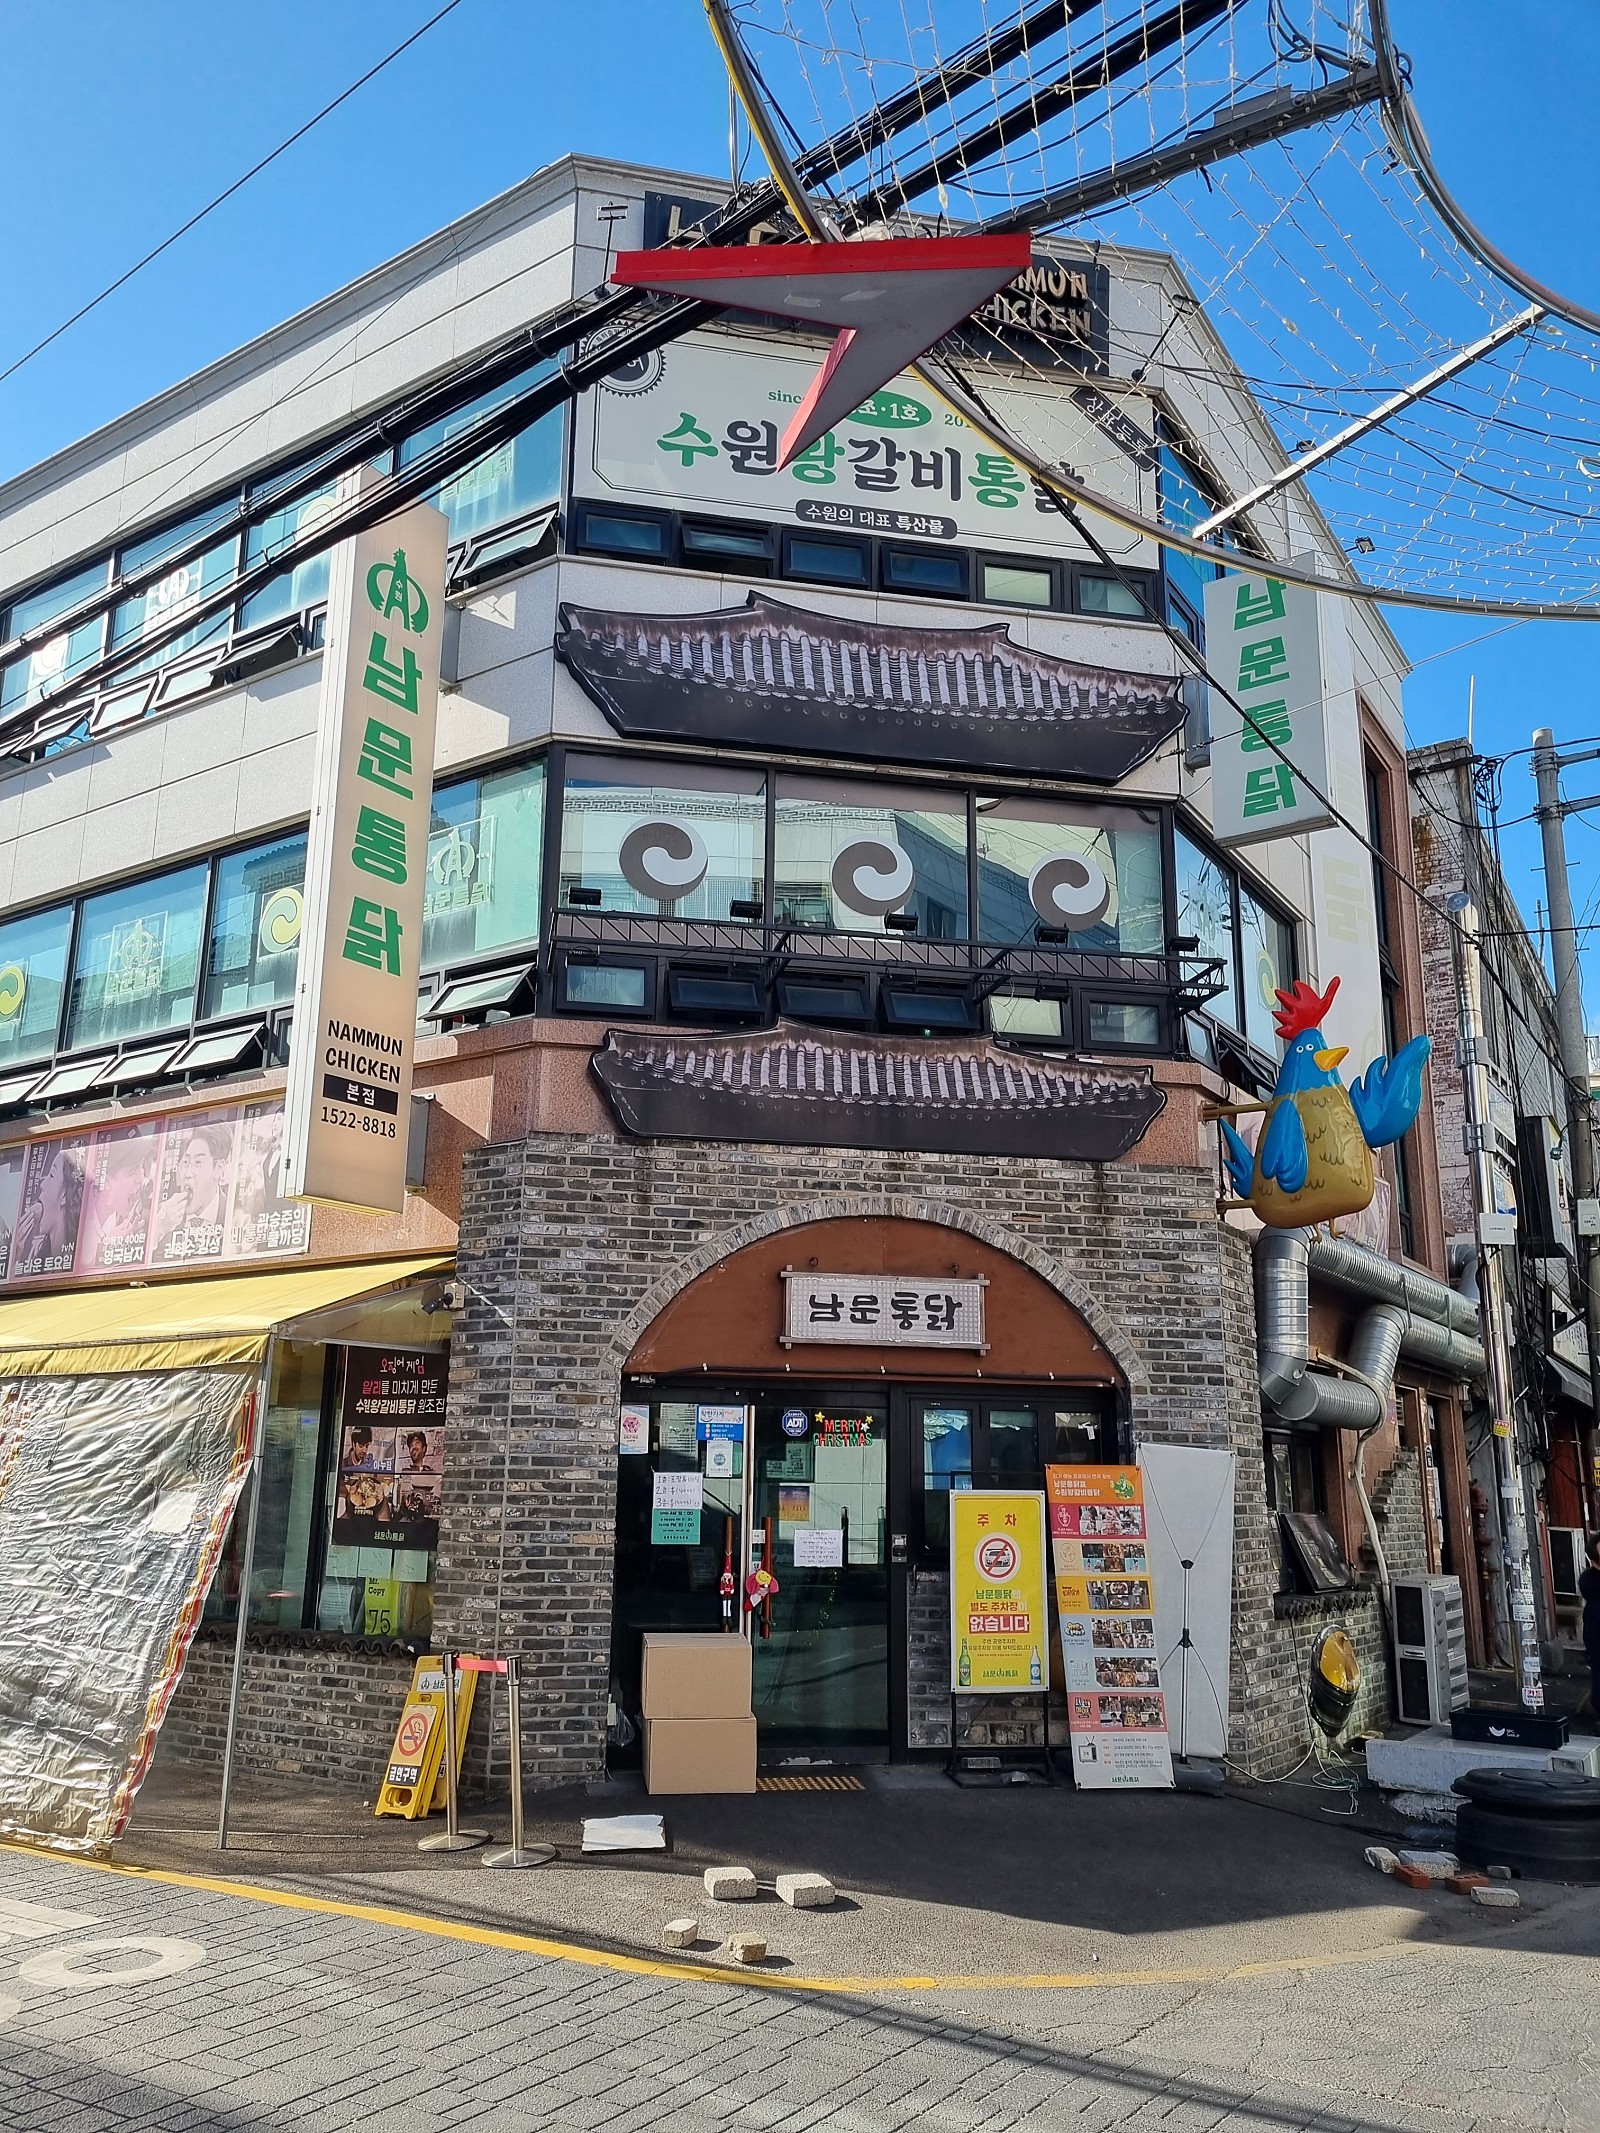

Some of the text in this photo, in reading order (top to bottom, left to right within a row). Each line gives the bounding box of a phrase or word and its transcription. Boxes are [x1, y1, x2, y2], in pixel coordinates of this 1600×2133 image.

[973, 296, 1091, 338] HICKEN
[768, 390, 805, 404] sinc
[805, 504, 945, 535] 수원의 대표 특산물
[1233, 577, 1298, 818] 남문통닭
[341, 631, 425, 977] 남문통닭
[327, 1019, 403, 1057] NAMMUN
[325, 1047, 401, 1084] CHICKEN
[346, 1083, 375, 1106] 본점
[321, 1106, 396, 1138] 1522-8818
[61, 1242, 75, 1253] tvN
[103, 1247, 145, 1265] 영국남자
[14, 1257, 42, 1275] 놀라운
[44, 1254, 73, 1272] 토요일
[809, 1292, 963, 1331] 남문통닭
[380, 1355, 425, 1375] 오징어 게임
[362, 1379, 439, 1395] 알리를 미치게 만든
[355, 1398, 446, 1415] 수원왕갈비통닭 원조집
[786, 1419, 804, 1429] ADT
[824, 1419, 861, 1433] MERRY
[813, 1432, 873, 1448] CHRISTMAS
[368, 1586, 386, 1597] Copy
[970, 1602, 988, 1612] 별도
[368, 1609, 391, 1634] 75
[969, 1615, 1030, 1632] 없습니다
[388, 1765, 418, 1783] 금연구역
